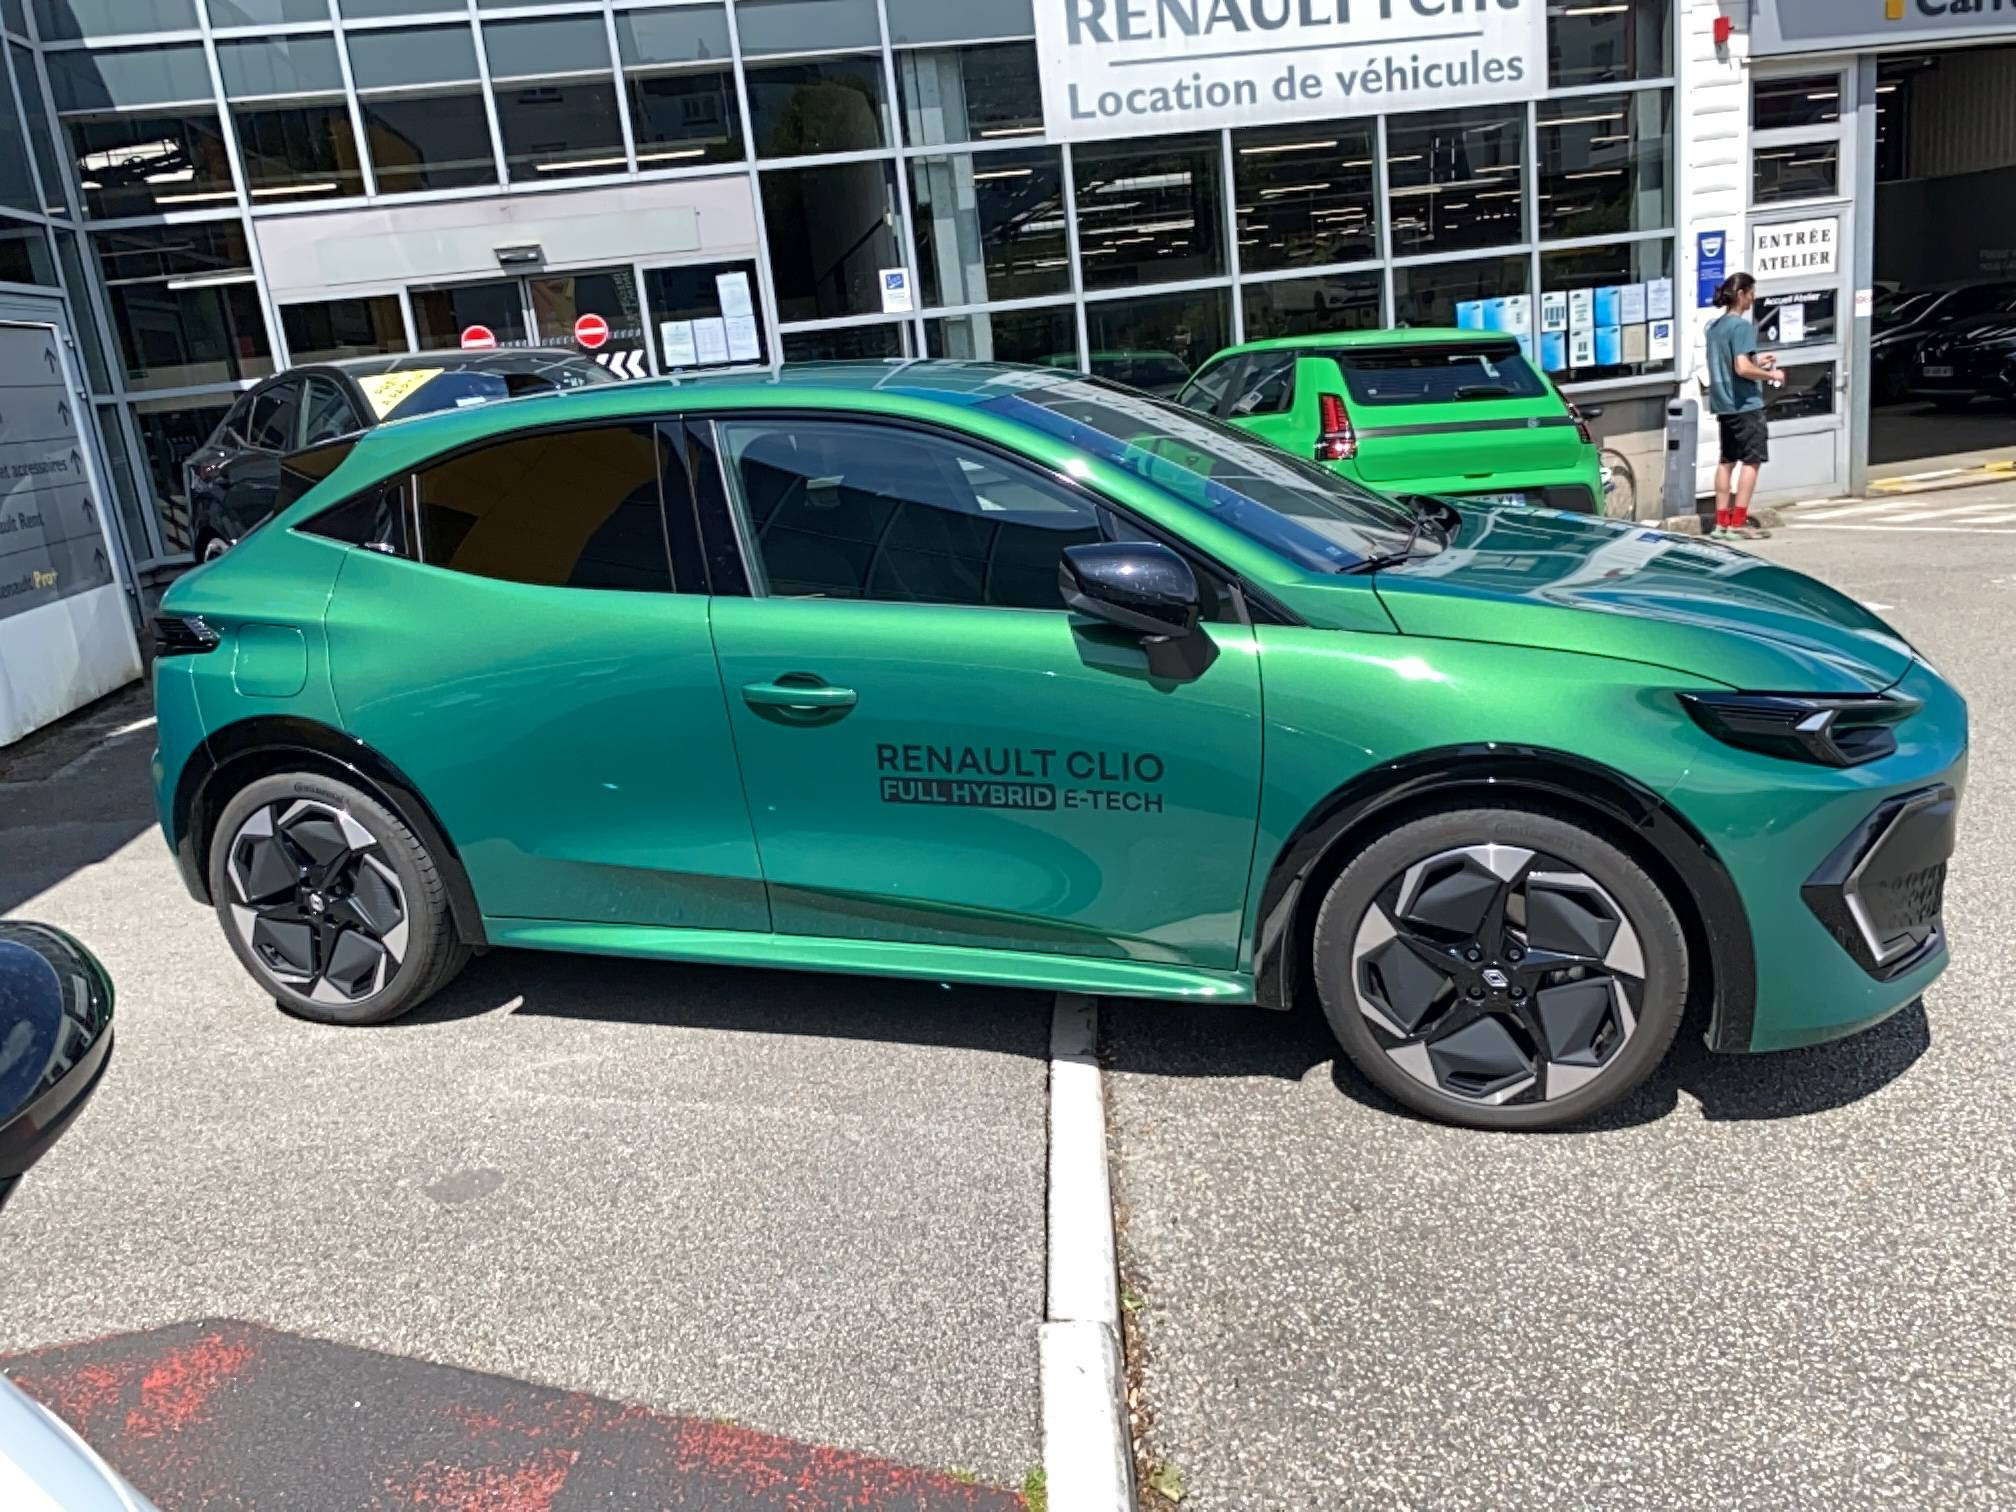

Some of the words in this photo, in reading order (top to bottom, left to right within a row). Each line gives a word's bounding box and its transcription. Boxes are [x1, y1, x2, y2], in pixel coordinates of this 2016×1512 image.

[1068, 72, 1257, 119] Location
[1273, 65, 1322, 100] de
[1336, 50, 1524, 96] véhicules
[1759, 228, 1831, 249] ENTRÉE
[1758, 251, 1830, 271] ATELIER
[877, 743, 1056, 778] RENAULT
[1066, 750, 1164, 783] CLIO
[884, 780, 947, 803] FULL
[951, 782, 1053, 808] HYBRID
[1064, 788, 1163, 814] E-TECH
